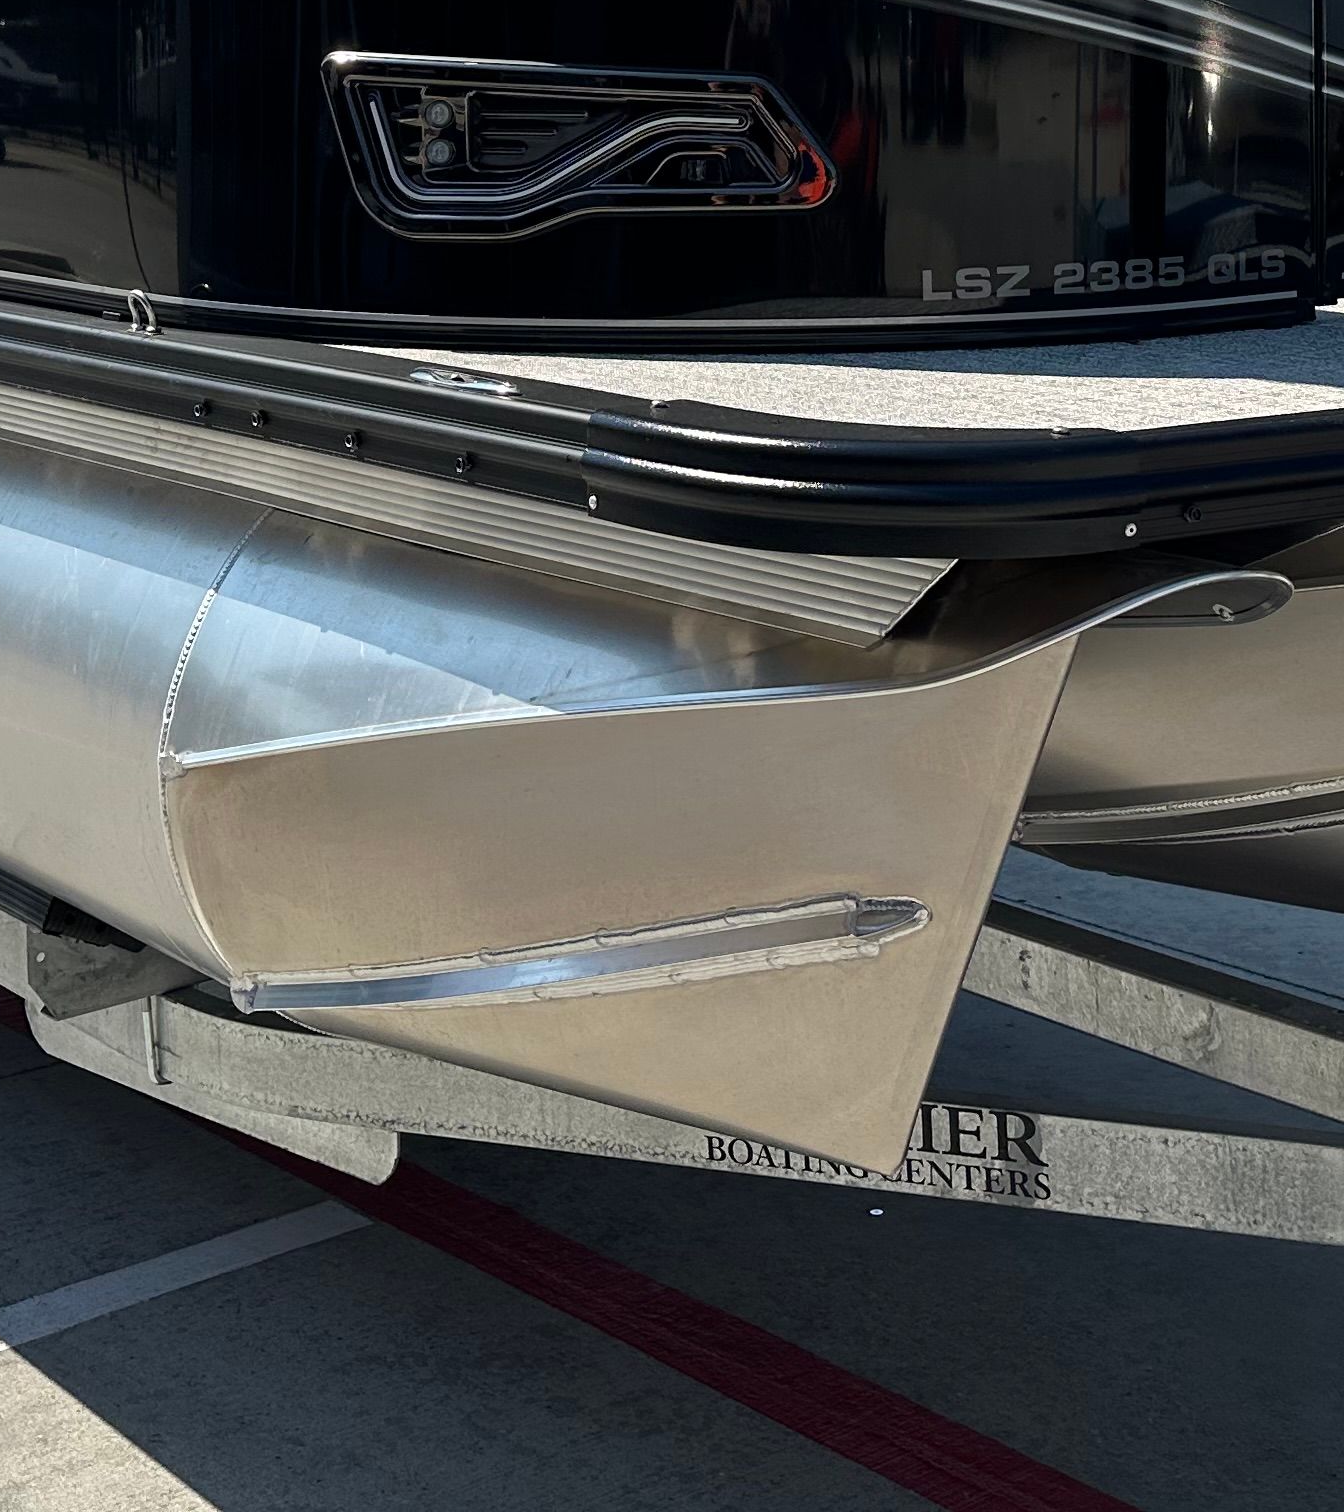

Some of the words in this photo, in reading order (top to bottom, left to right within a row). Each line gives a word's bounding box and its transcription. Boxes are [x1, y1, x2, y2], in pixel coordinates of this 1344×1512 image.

[921, 264, 1031, 302] LSZ
[1053, 255, 1186, 295] 2385
[1207, 248, 1287, 285] QLS
[880, 1157, 1052, 1201] ENTERS
